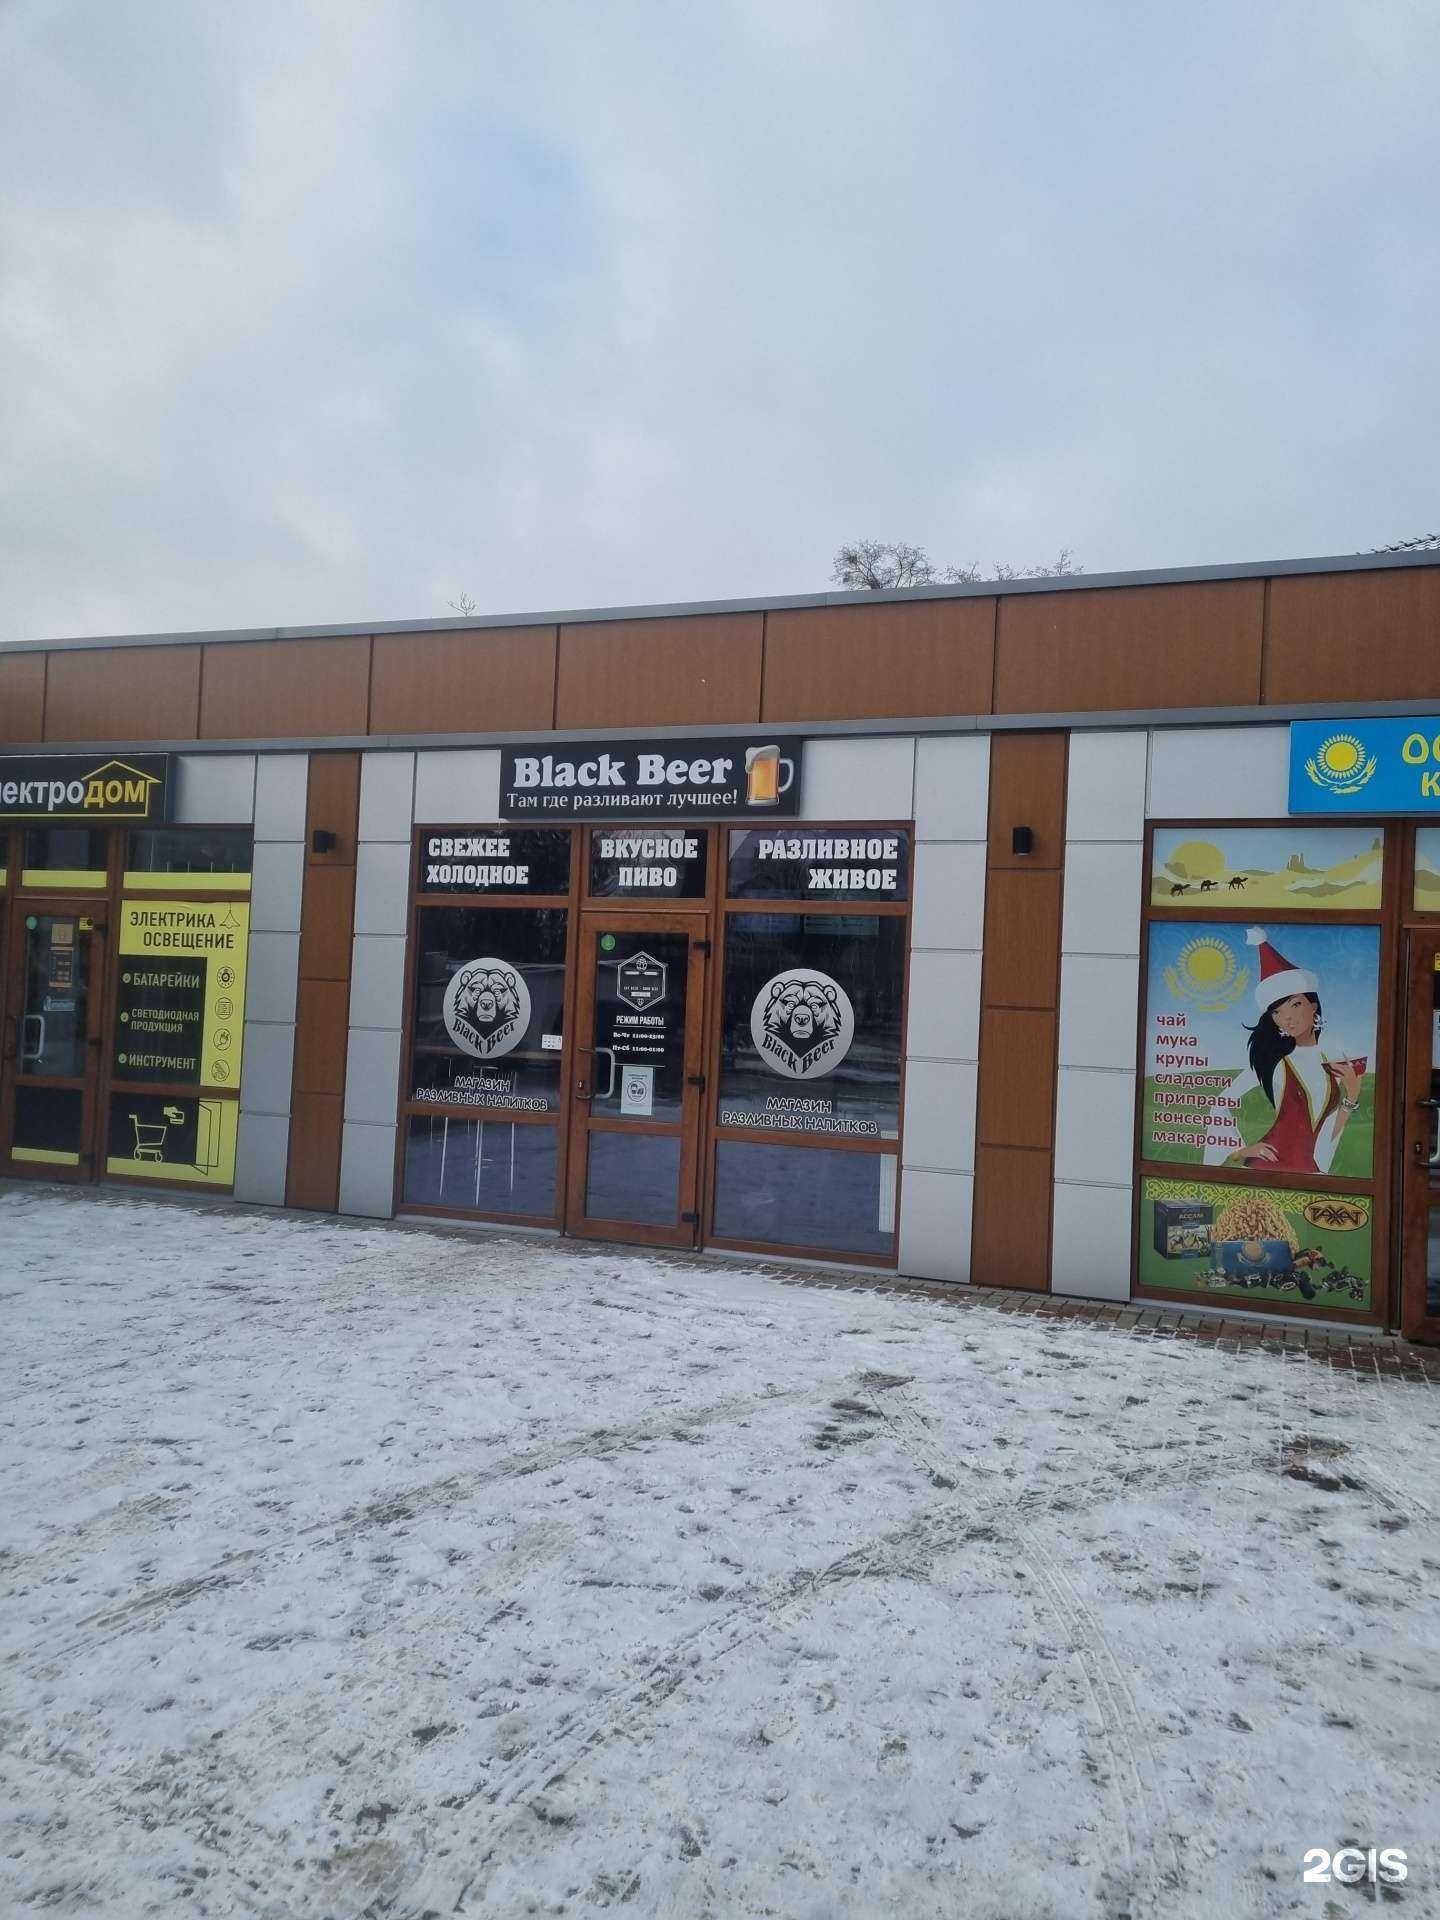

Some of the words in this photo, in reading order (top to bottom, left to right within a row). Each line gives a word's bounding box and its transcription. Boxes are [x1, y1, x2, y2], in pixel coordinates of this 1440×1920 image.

[1402, 733, 1440, 764] О
[513, 755, 626, 788] Black
[637, 753, 733, 785] Beer
[0, 780, 145, 811] ектродом
[506, 792, 538, 808] Там
[542, 795, 569, 810] где
[573, 793, 664, 811] разливают
[666, 789, 738, 808] лучшее!
[428, 838, 510, 858] СВЕЖЕЕ
[600, 838, 698, 860] ВКУСНОЕ
[758, 838, 898, 860] РАЗЛИВНОЕ
[426, 865, 529, 887] ХОЛОДНОЕ
[618, 866, 677, 888] ПИВО
[808, 868, 897, 890] ЖИВОЕ
[129, 911, 216, 929] ЭЛЕКТРИКА
[143, 931, 234, 951] ОСВЕЩЕНИЕ
[132, 972, 200, 989] БАТАРЕЙКИ
[130, 1008, 199, 1022] СВЕТОДИОДНАЯ
[616, 1015, 638, 1025] РЕЖИМ
[639, 1016, 664, 1026] РАБОТЫ
[1156, 1013, 1186, 1029] чай
[130, 1020, 183, 1033] ПРОДУКЦИЯ
[453, 1020, 483, 1049] Black
[485, 1021, 516, 1053] Beer
[1156, 1033, 1197, 1050] мука
[128, 1054, 197, 1071] ИНСТРУМЕНТ
[762, 1034, 798, 1072] Black
[802, 1038, 837, 1073] Beer
[1155, 1052, 1209, 1070] крупы
[454, 1076, 511, 1093] МАГАЗИН
[1154, 1071, 1232, 1089] сладости
[416, 1088, 485, 1107] РАЗЛИВНЫХ
[486, 1094, 548, 1111] НАПИТКОВ
[765, 1097, 832, 1114] МАГАЗИН
[1153, 1091, 1242, 1110] приправы
[721, 1110, 804, 1129] РАЗЛИВНЫХ
[805, 1116, 878, 1135] НАПИТКОВ
[1153, 1112, 1237, 1130] консервы
[1152, 1130, 1243, 1149] макароны
